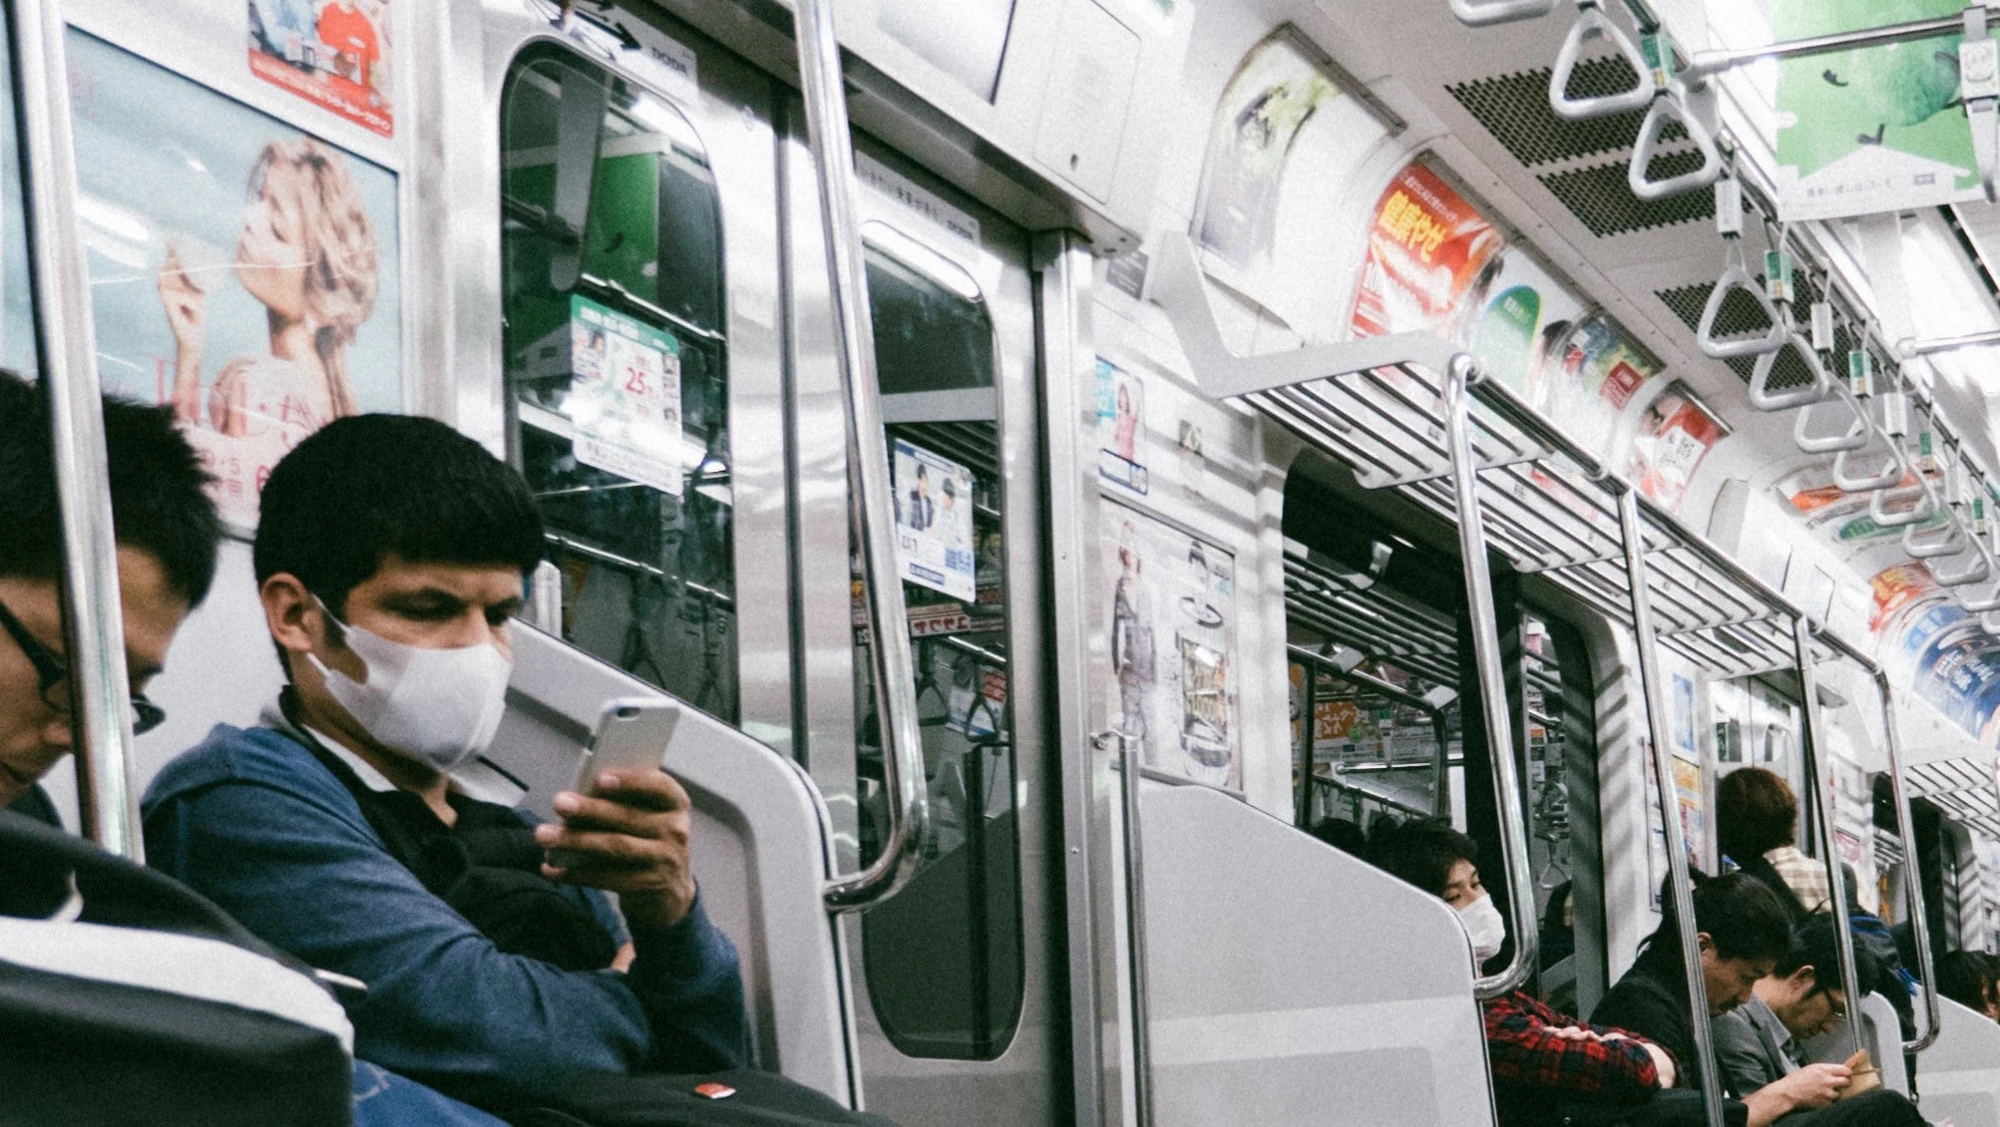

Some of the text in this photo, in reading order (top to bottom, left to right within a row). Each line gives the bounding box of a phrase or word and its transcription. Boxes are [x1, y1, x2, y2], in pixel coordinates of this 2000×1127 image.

[1378, 190, 1447, 263] 健康やせ
[625, 366, 646, 395] 25
